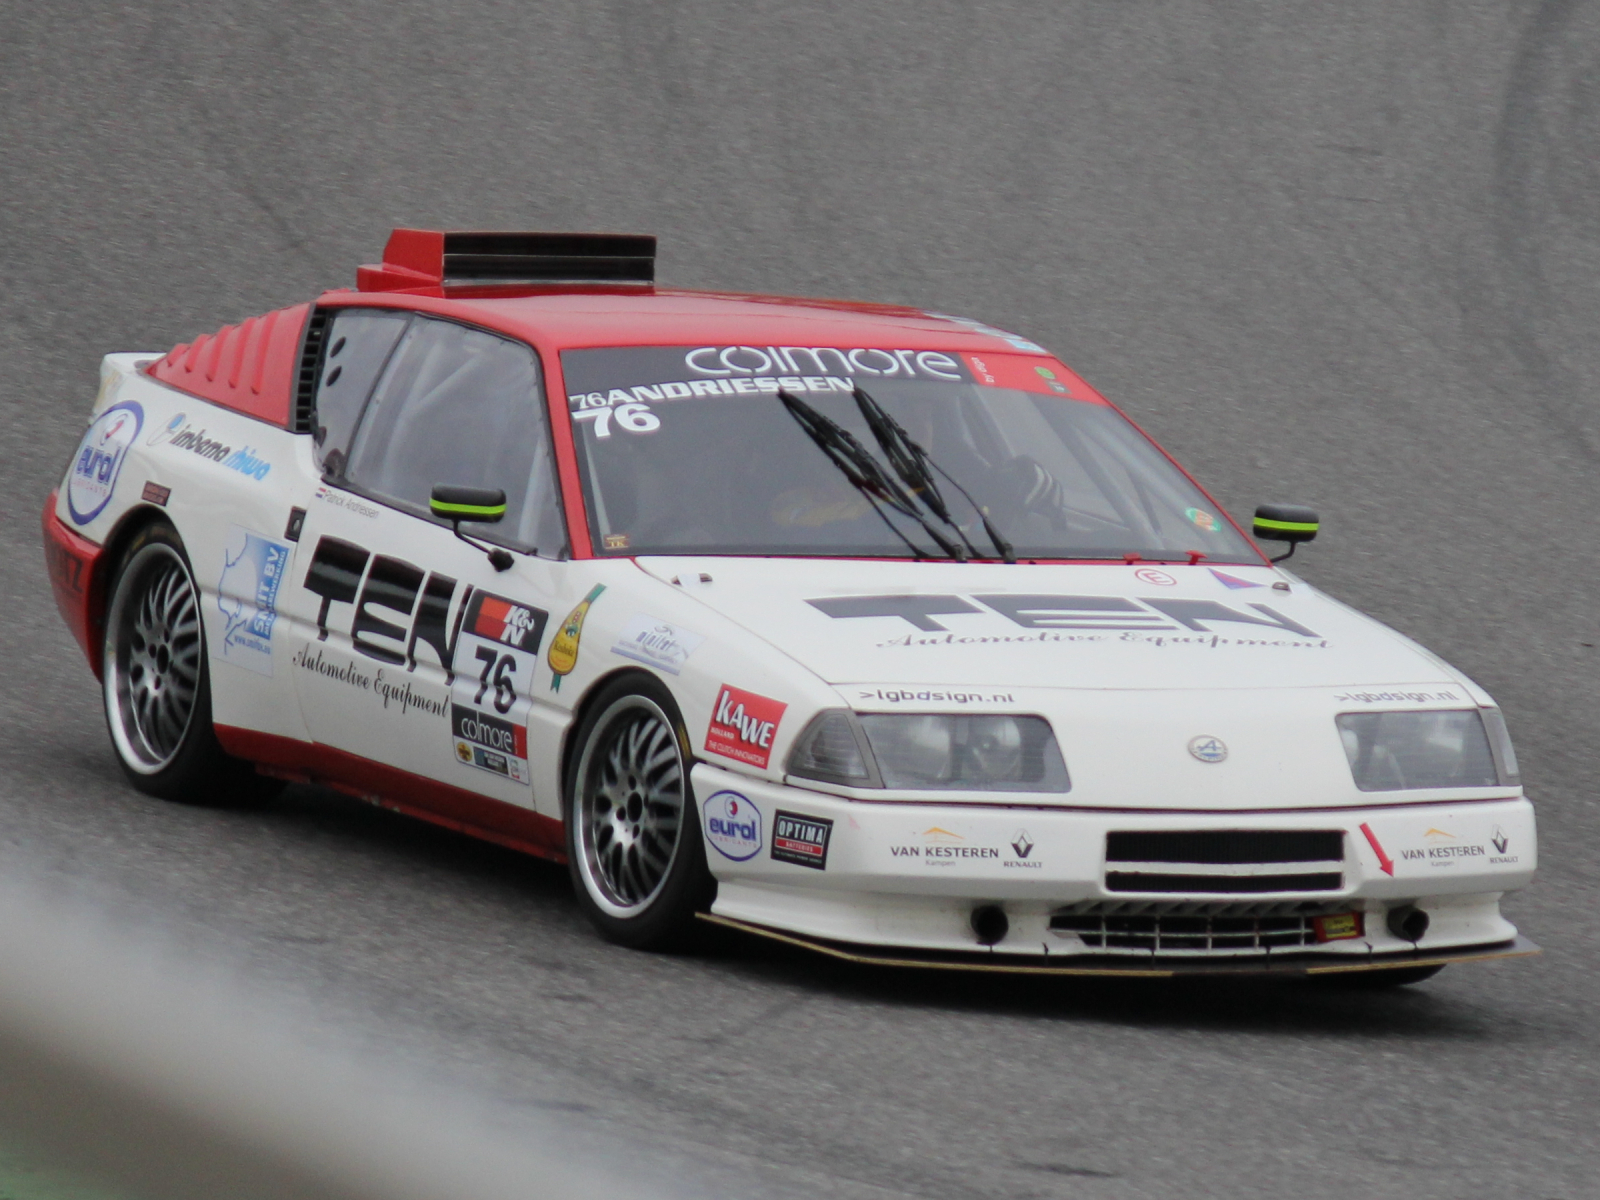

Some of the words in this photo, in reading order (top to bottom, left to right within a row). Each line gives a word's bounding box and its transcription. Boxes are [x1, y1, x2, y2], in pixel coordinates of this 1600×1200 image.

[685, 345, 962, 381] colmore
[571, 402, 661, 438] 76
[76, 444, 121, 486] eurol
[253, 580, 271, 633] SMIT
[263, 546, 281, 577] BV
[303, 534, 475, 687] TEN
[803, 593, 1324, 638] TEN
[875, 631, 1109, 649] Automotive
[1118, 631, 1334, 649] Equipment
[291, 641, 371, 690] Automotive
[373, 667, 449, 718] Equipment
[474, 644, 517, 714] 76
[461, 710, 513, 752] colmore
[710, 726, 736, 740] HOLLAND
[715, 689, 776, 749] KAWE
[709, 817, 757, 842] eurol
[778, 820, 825, 844] OPTIMA
[785, 841, 814, 853] BATTERIES
[890, 846, 920, 857] VAN
[925, 846, 999, 858] KESTEREN
[1401, 848, 1426, 860] VAN
[1428, 845, 1486, 859] KESTEREN
[1489, 856, 1519, 864] RENAULT
[925, 859, 956, 868] Kampen
[1003, 860, 1043, 869] RENAULT
